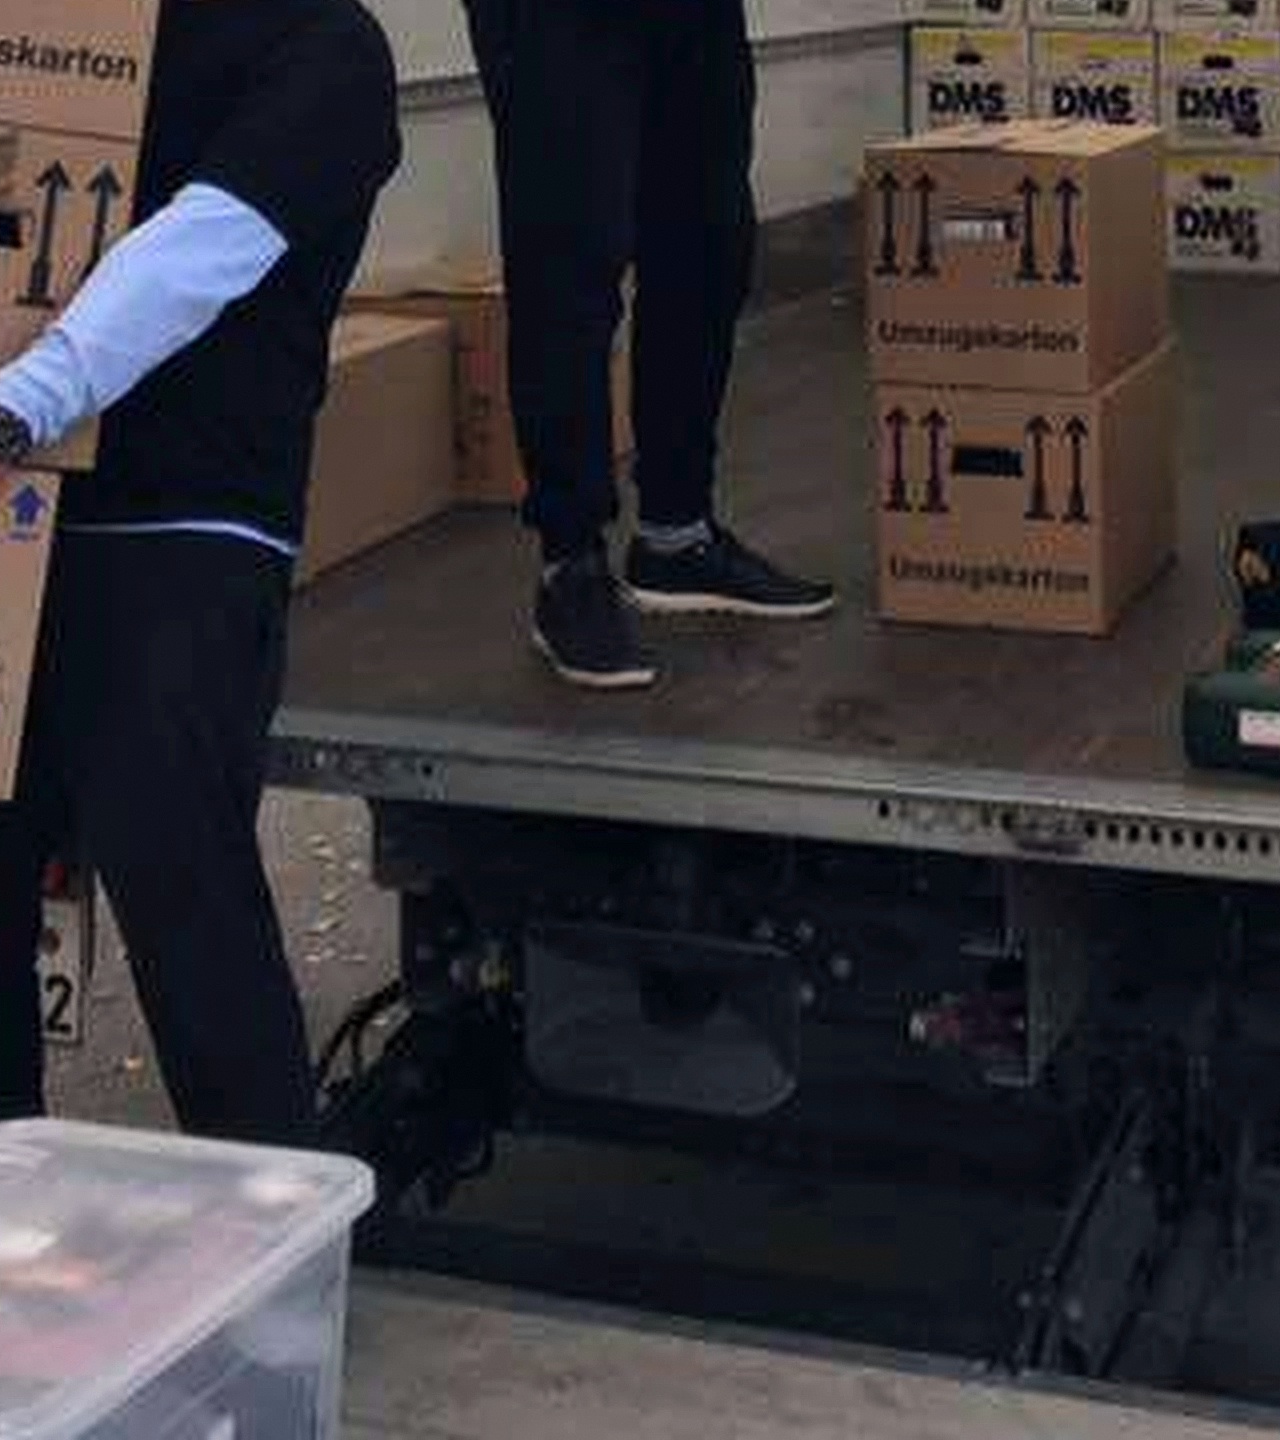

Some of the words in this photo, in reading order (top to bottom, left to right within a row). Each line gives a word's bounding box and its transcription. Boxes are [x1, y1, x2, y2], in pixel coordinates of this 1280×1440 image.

[929, 82, 1006, 114] DMS
[1052, 85, 1131, 119] DMS
[1178, 86, 1259, 120] DMS
[878, 320, 1078, 352] Umzugskarton
